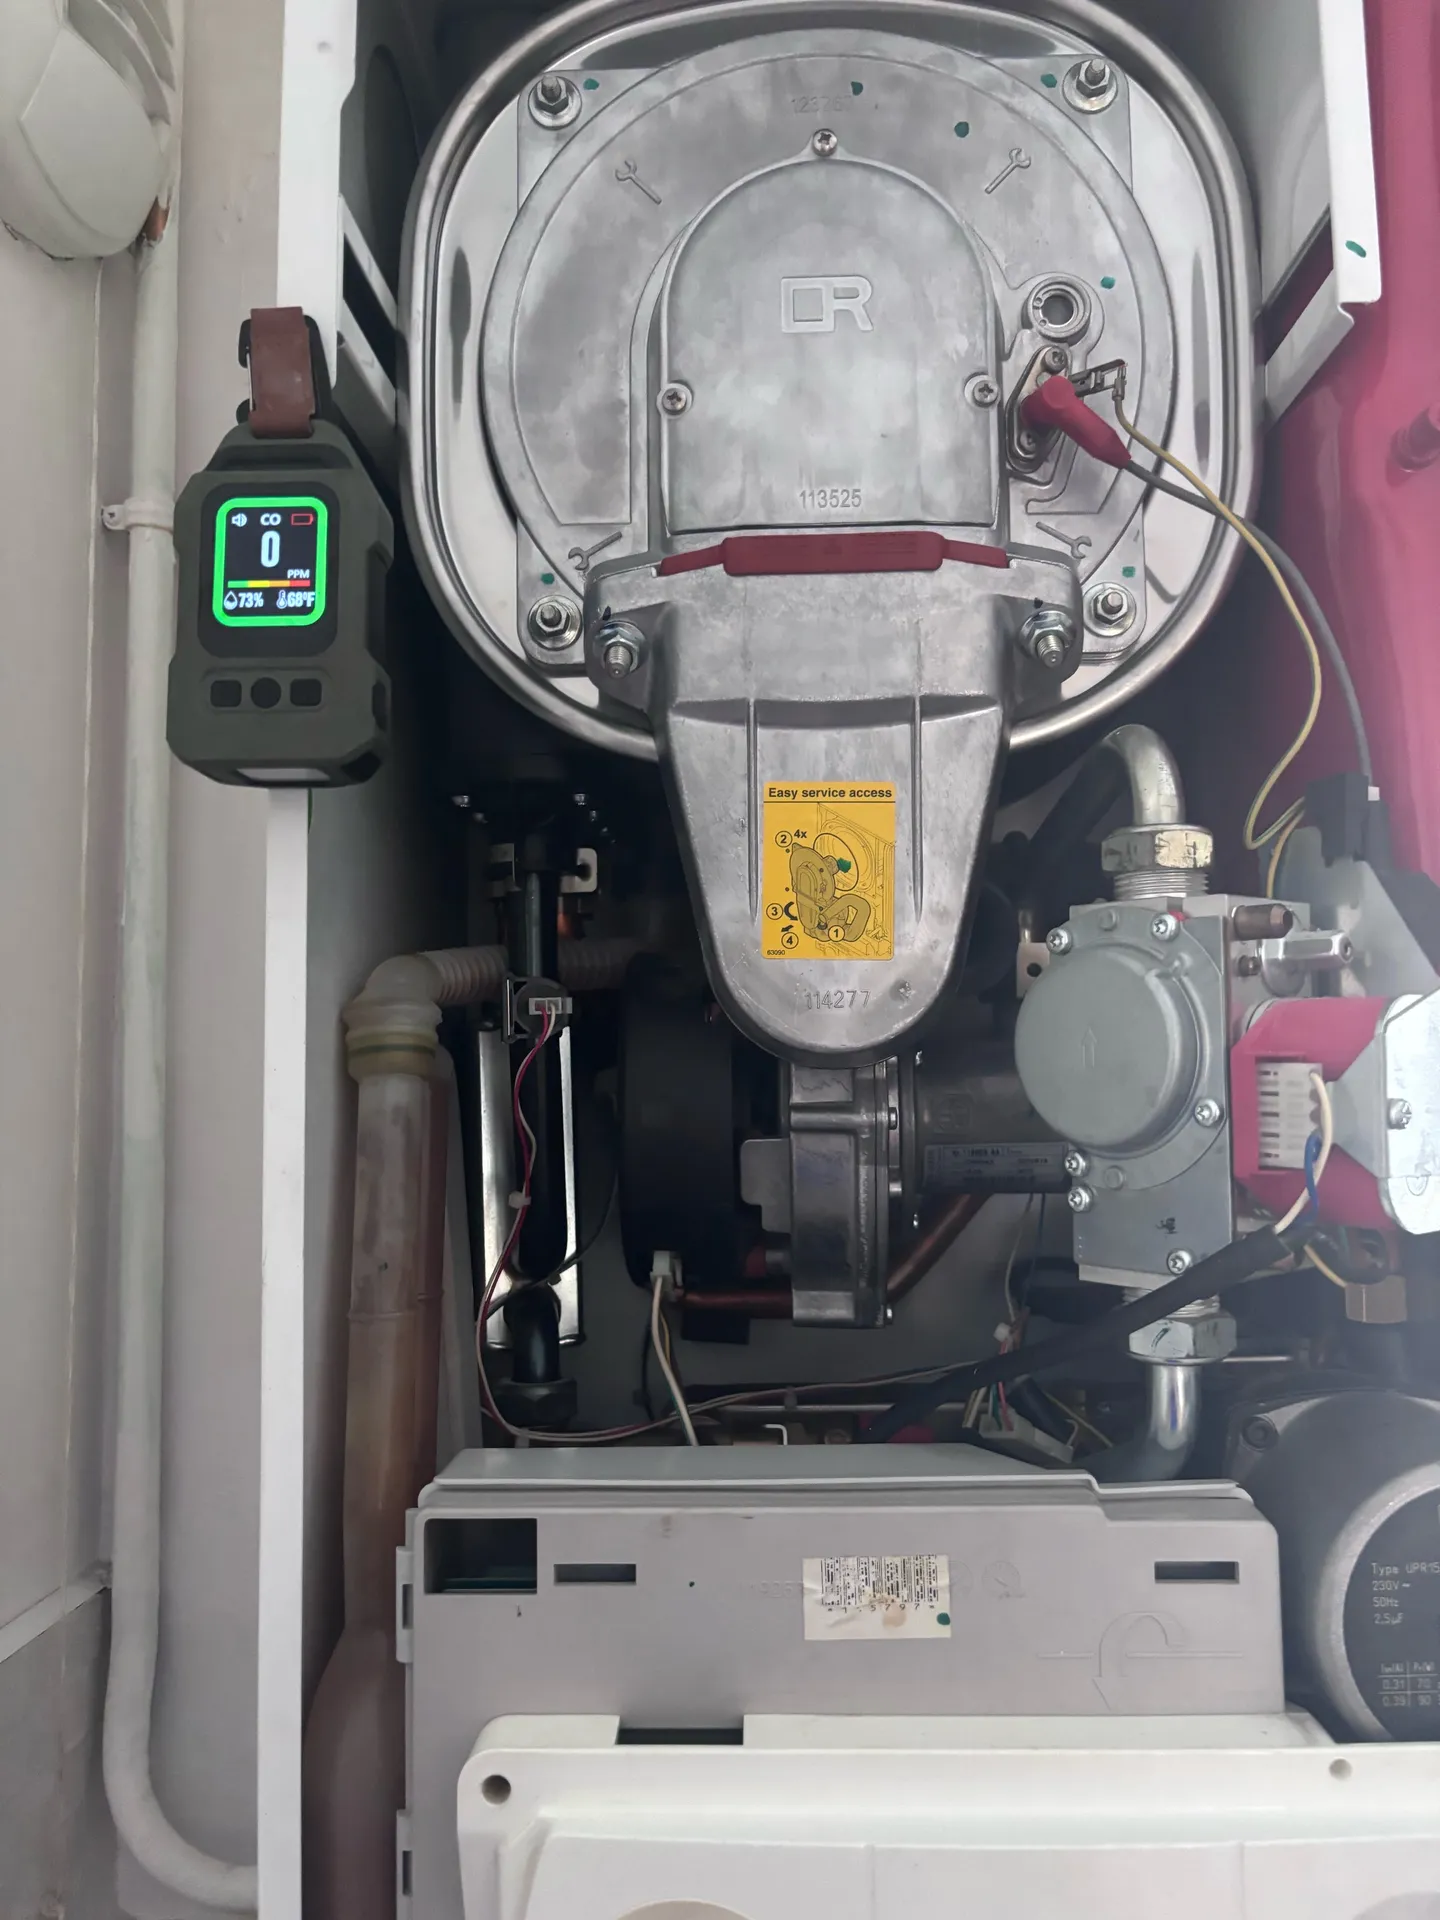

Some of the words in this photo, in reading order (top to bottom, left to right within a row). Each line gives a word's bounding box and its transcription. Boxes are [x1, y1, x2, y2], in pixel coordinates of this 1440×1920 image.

[799, 488, 862, 509] 113525
[260, 513, 282, 526] CO
[260, 530, 281, 568] 0
[287, 569, 310, 579] PPM
[238, 592, 265, 608] 73%
[768, 787, 798, 800] Easy
[801, 788, 846, 798] service
[849, 788, 893, 798] access
[793, 829, 808, 839] 4x
[804, 990, 871, 1010] 114277
[1371, 1562, 1400, 1577] Type
[1372, 1597, 1400, 1608] 50Hz
